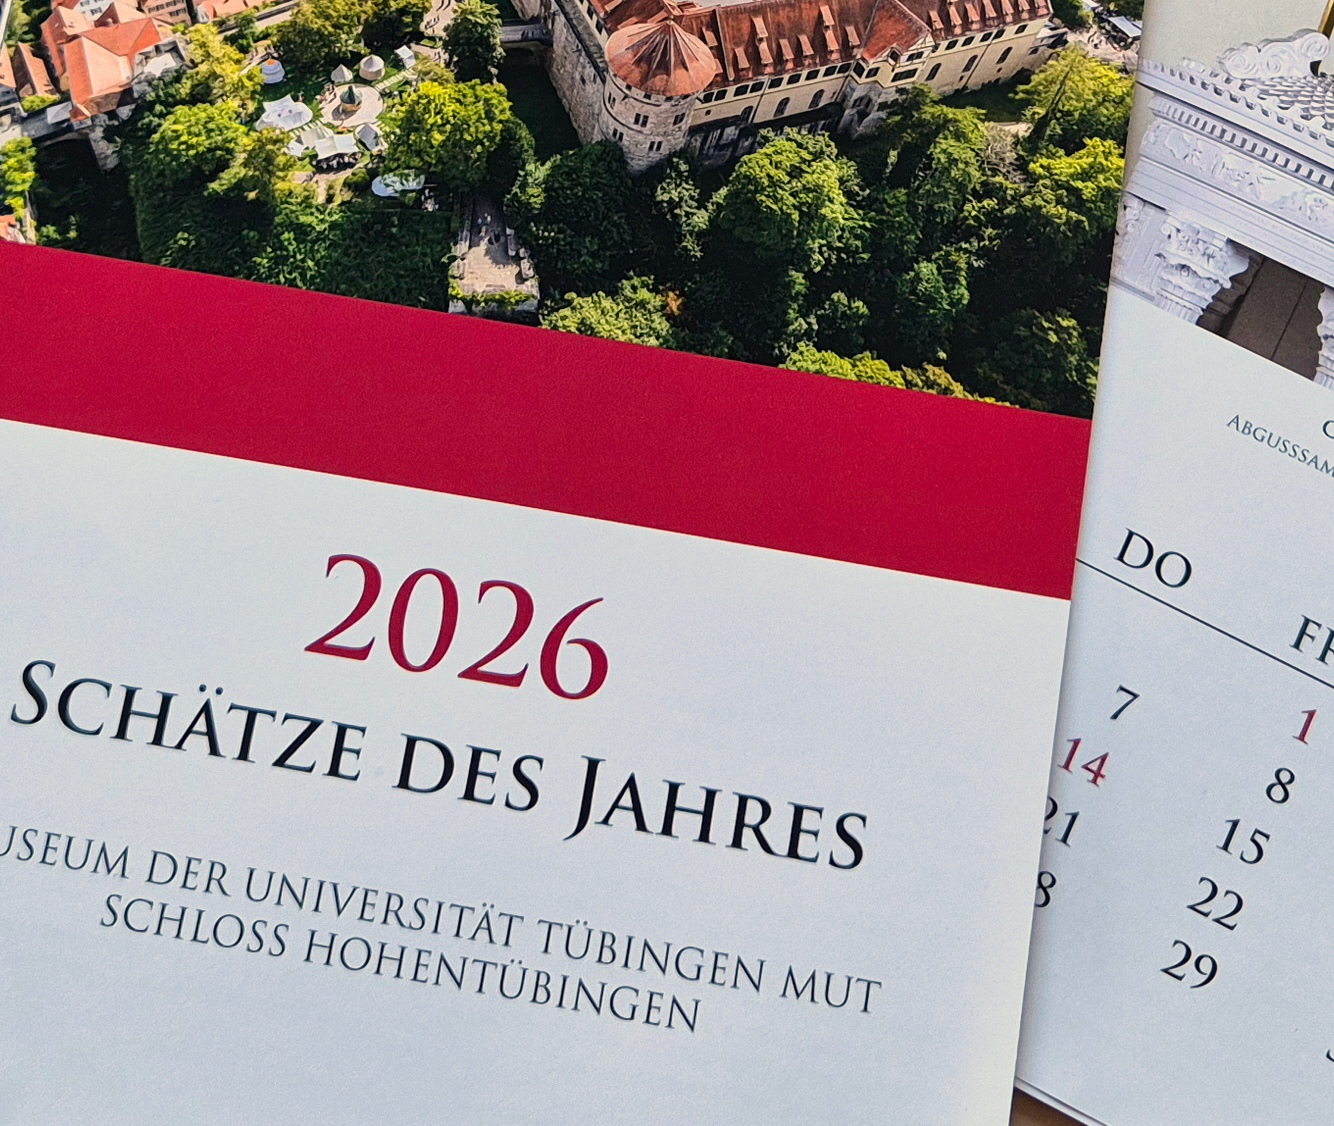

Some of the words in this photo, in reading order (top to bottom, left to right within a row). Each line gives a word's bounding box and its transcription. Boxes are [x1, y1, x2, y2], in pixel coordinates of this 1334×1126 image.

[1113, 528, 1193, 590] DO
[304, 554, 608, 700] 2026
[10, 660, 367, 781] SCHÄTZE
[393, 731, 545, 814] DES
[563, 755, 867, 870] JAHRES
[1109, 684, 1141, 722] 7
[1265, 767, 1296, 805] 8
[1291, 708, 1317, 745] 1
[1057, 737, 1110, 788] 14
[1215, 817, 1271, 865] 15
[99, 893, 289, 958] SCHLOSS
[302, 931, 703, 1034] HOHENTÜBINGEN
[144, 850, 231, 897] DER
[245, 866, 524, 949] UNIVERSITÄT
[536, 919, 767, 995] TÜBINGEN
[779, 965, 882, 1015] MUT
[1034, 870, 1057, 908] 8
[1159, 939, 1218, 990] 29
[1186, 876, 1244, 931] 22
